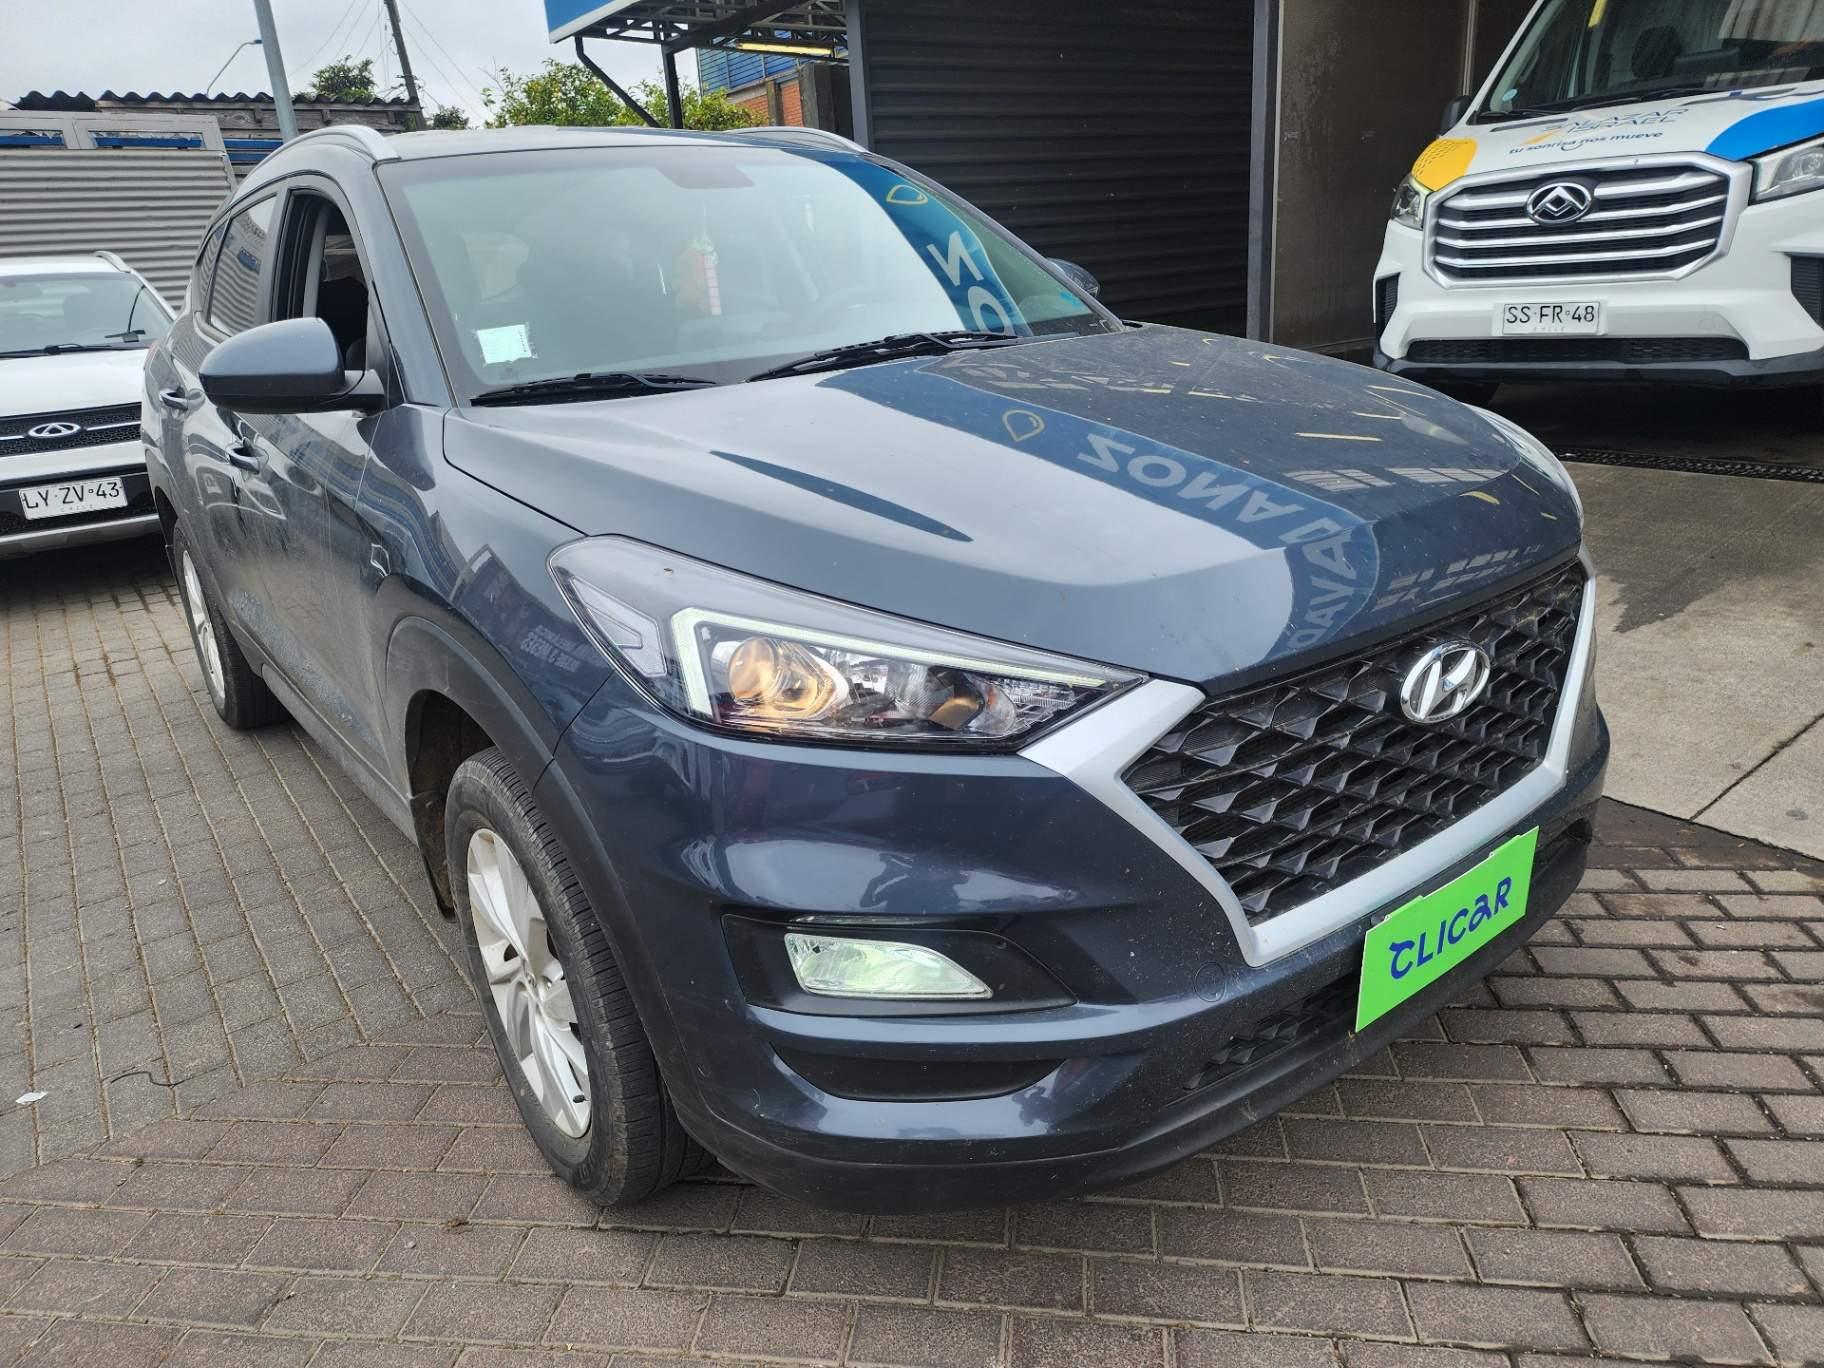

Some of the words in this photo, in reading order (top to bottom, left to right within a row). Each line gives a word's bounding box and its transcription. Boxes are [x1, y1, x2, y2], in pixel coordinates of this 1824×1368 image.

[1526, 138, 1577, 152] sonrisa
[1579, 135, 1605, 146] nos
[1609, 131, 1664, 142] mueve
